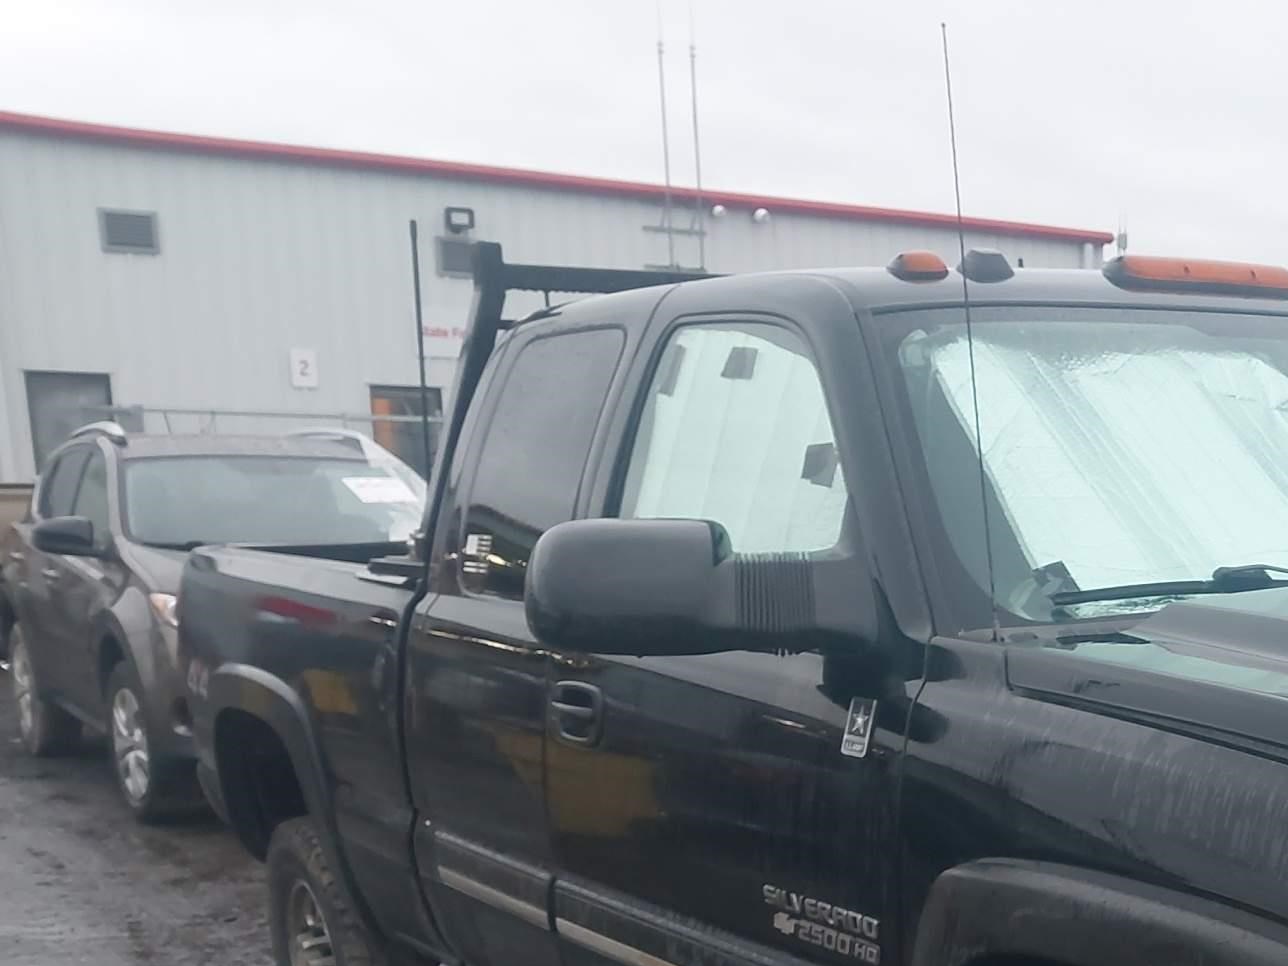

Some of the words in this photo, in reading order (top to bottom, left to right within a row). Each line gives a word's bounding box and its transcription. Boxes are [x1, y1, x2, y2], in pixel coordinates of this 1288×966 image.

[299, 359, 312, 377] 2
[763, 884, 879, 939] SILVERADO
[797, 919, 851, 955] 2500
